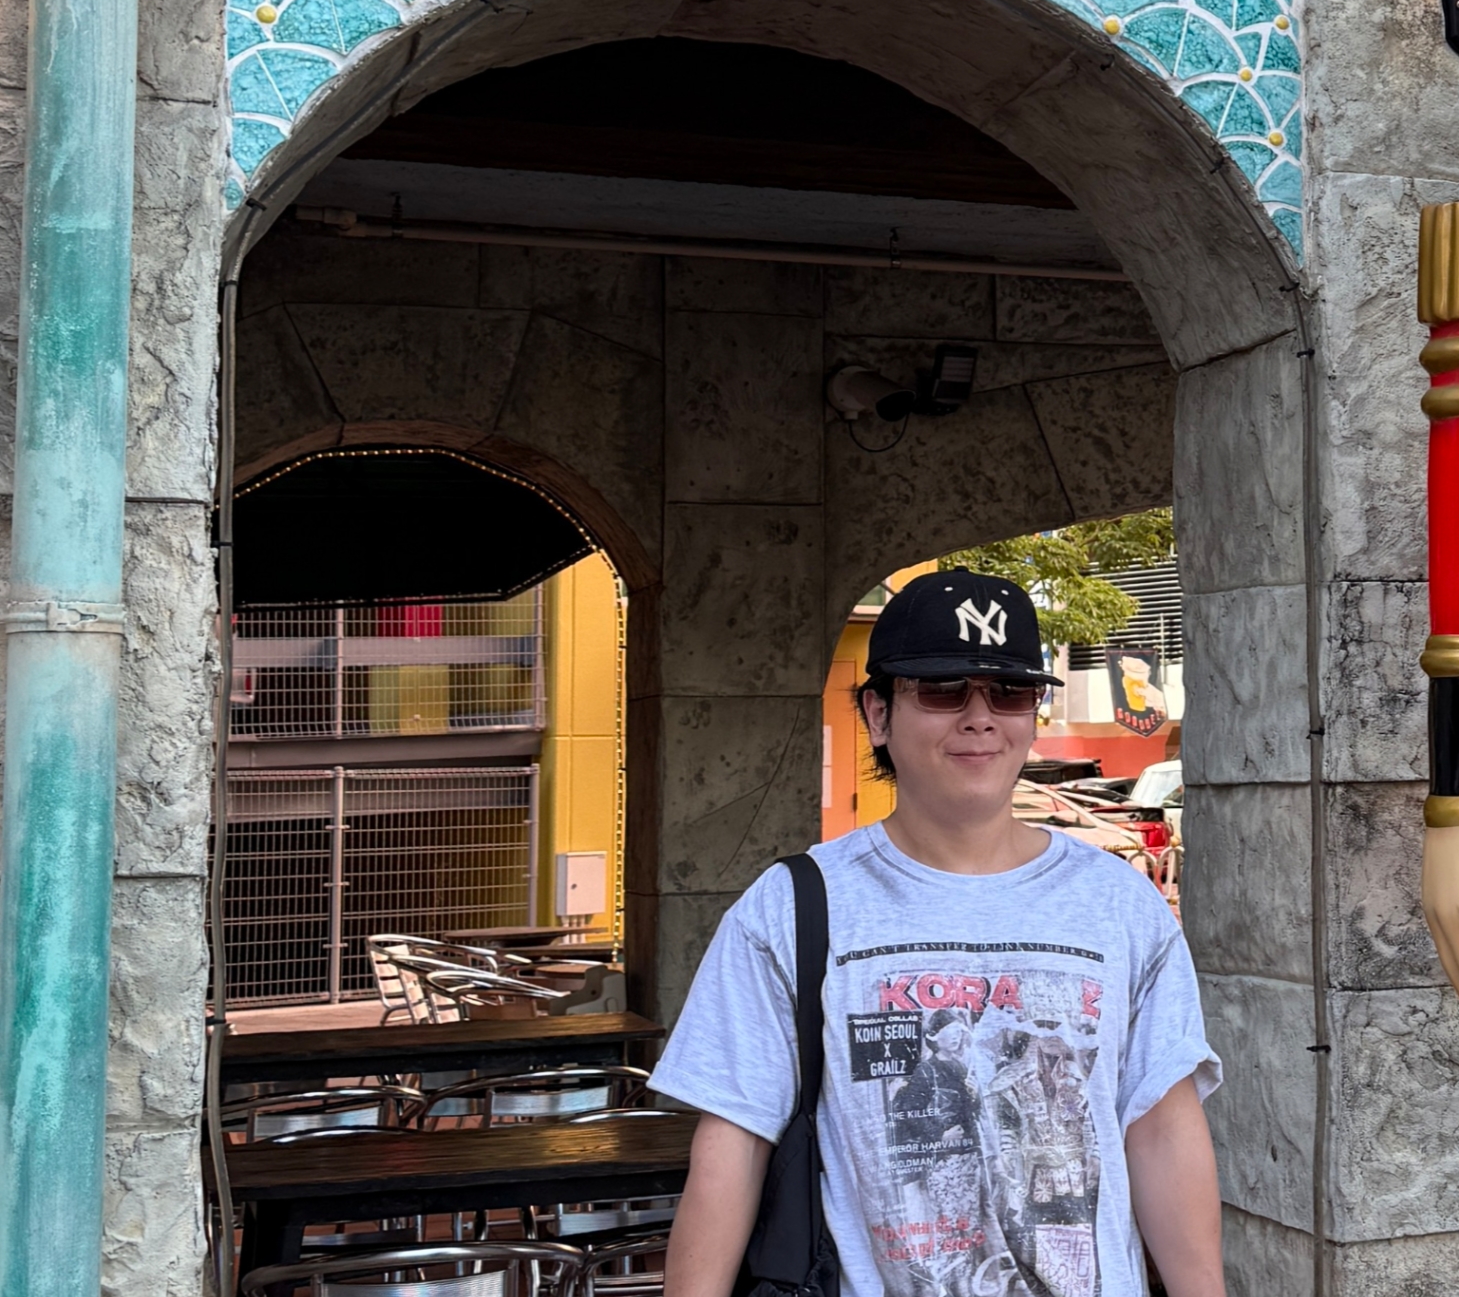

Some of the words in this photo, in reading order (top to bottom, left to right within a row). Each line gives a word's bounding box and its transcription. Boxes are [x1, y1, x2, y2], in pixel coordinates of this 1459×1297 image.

[955, 598, 1008, 646] NY
[855, 1025, 881, 1043] KOIN
[884, 1023, 918, 1040] SEOUL
[907, 1107, 941, 1118] KILLER
